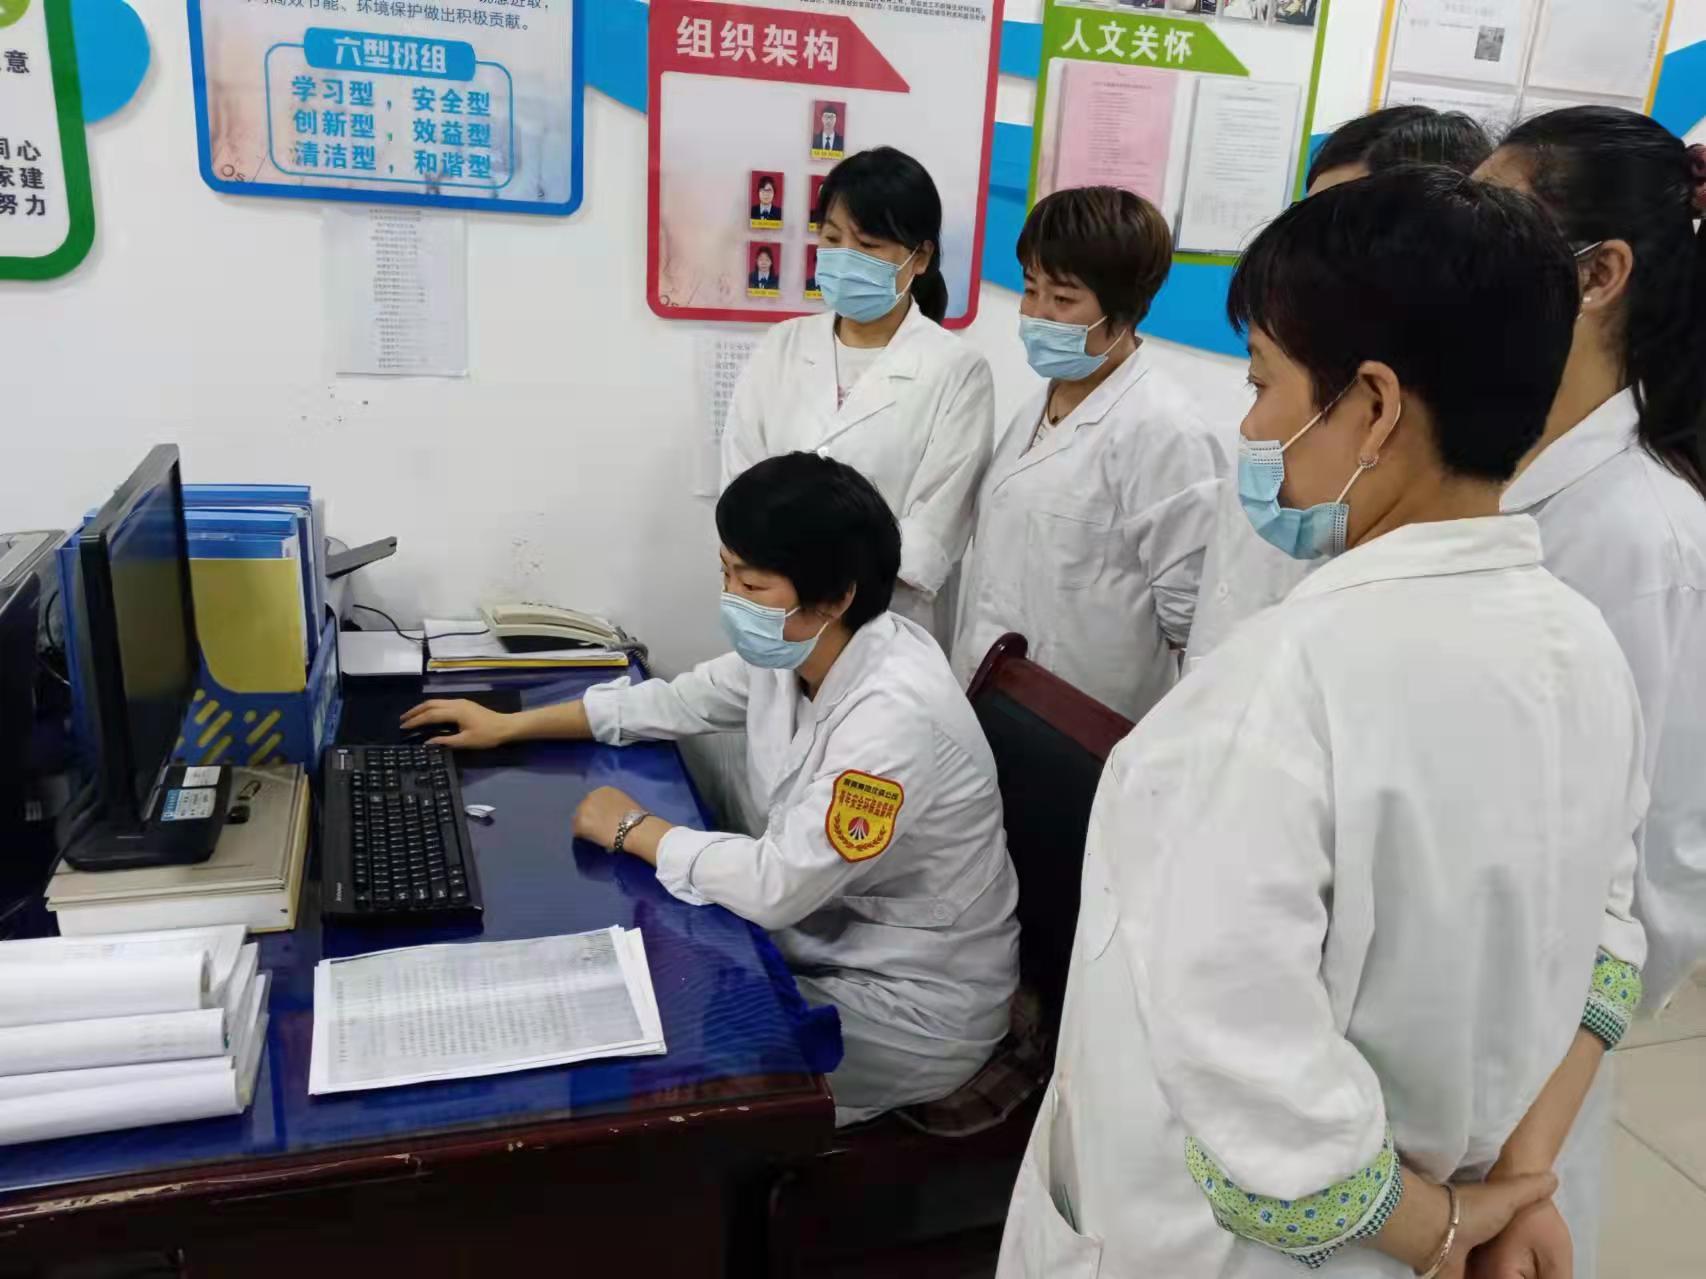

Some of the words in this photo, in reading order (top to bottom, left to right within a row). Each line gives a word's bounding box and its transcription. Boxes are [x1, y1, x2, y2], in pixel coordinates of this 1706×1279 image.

[334, 36, 447, 73] 六型班组
[675, 15, 839, 71] 组织架构
[1061, 18, 1194, 63] 人文关怀
